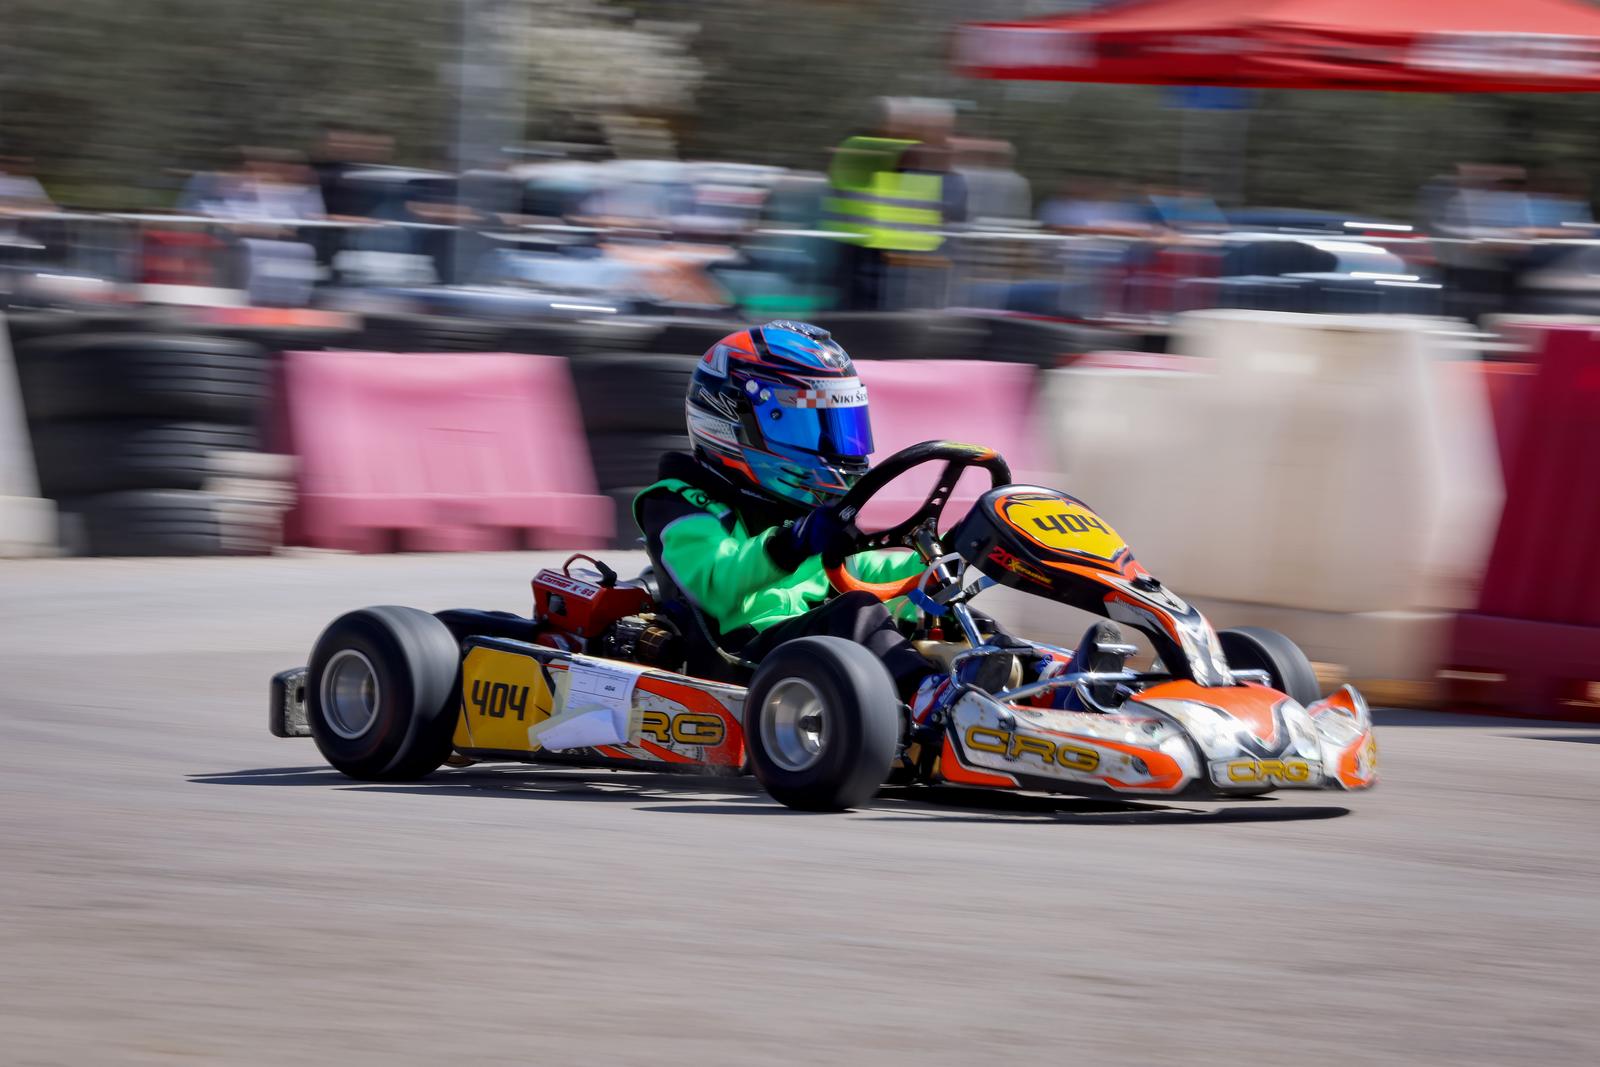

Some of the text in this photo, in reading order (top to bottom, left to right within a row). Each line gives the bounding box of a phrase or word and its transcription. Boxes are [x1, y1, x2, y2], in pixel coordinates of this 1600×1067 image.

[831, 394, 853, 404] NIKI
[1032, 513, 1110, 535] 404
[471, 680, 530, 721] 404
[640, 710, 726, 746] RG
[964, 724, 1100, 772] CRG
[1227, 758, 1311, 783] CRG
